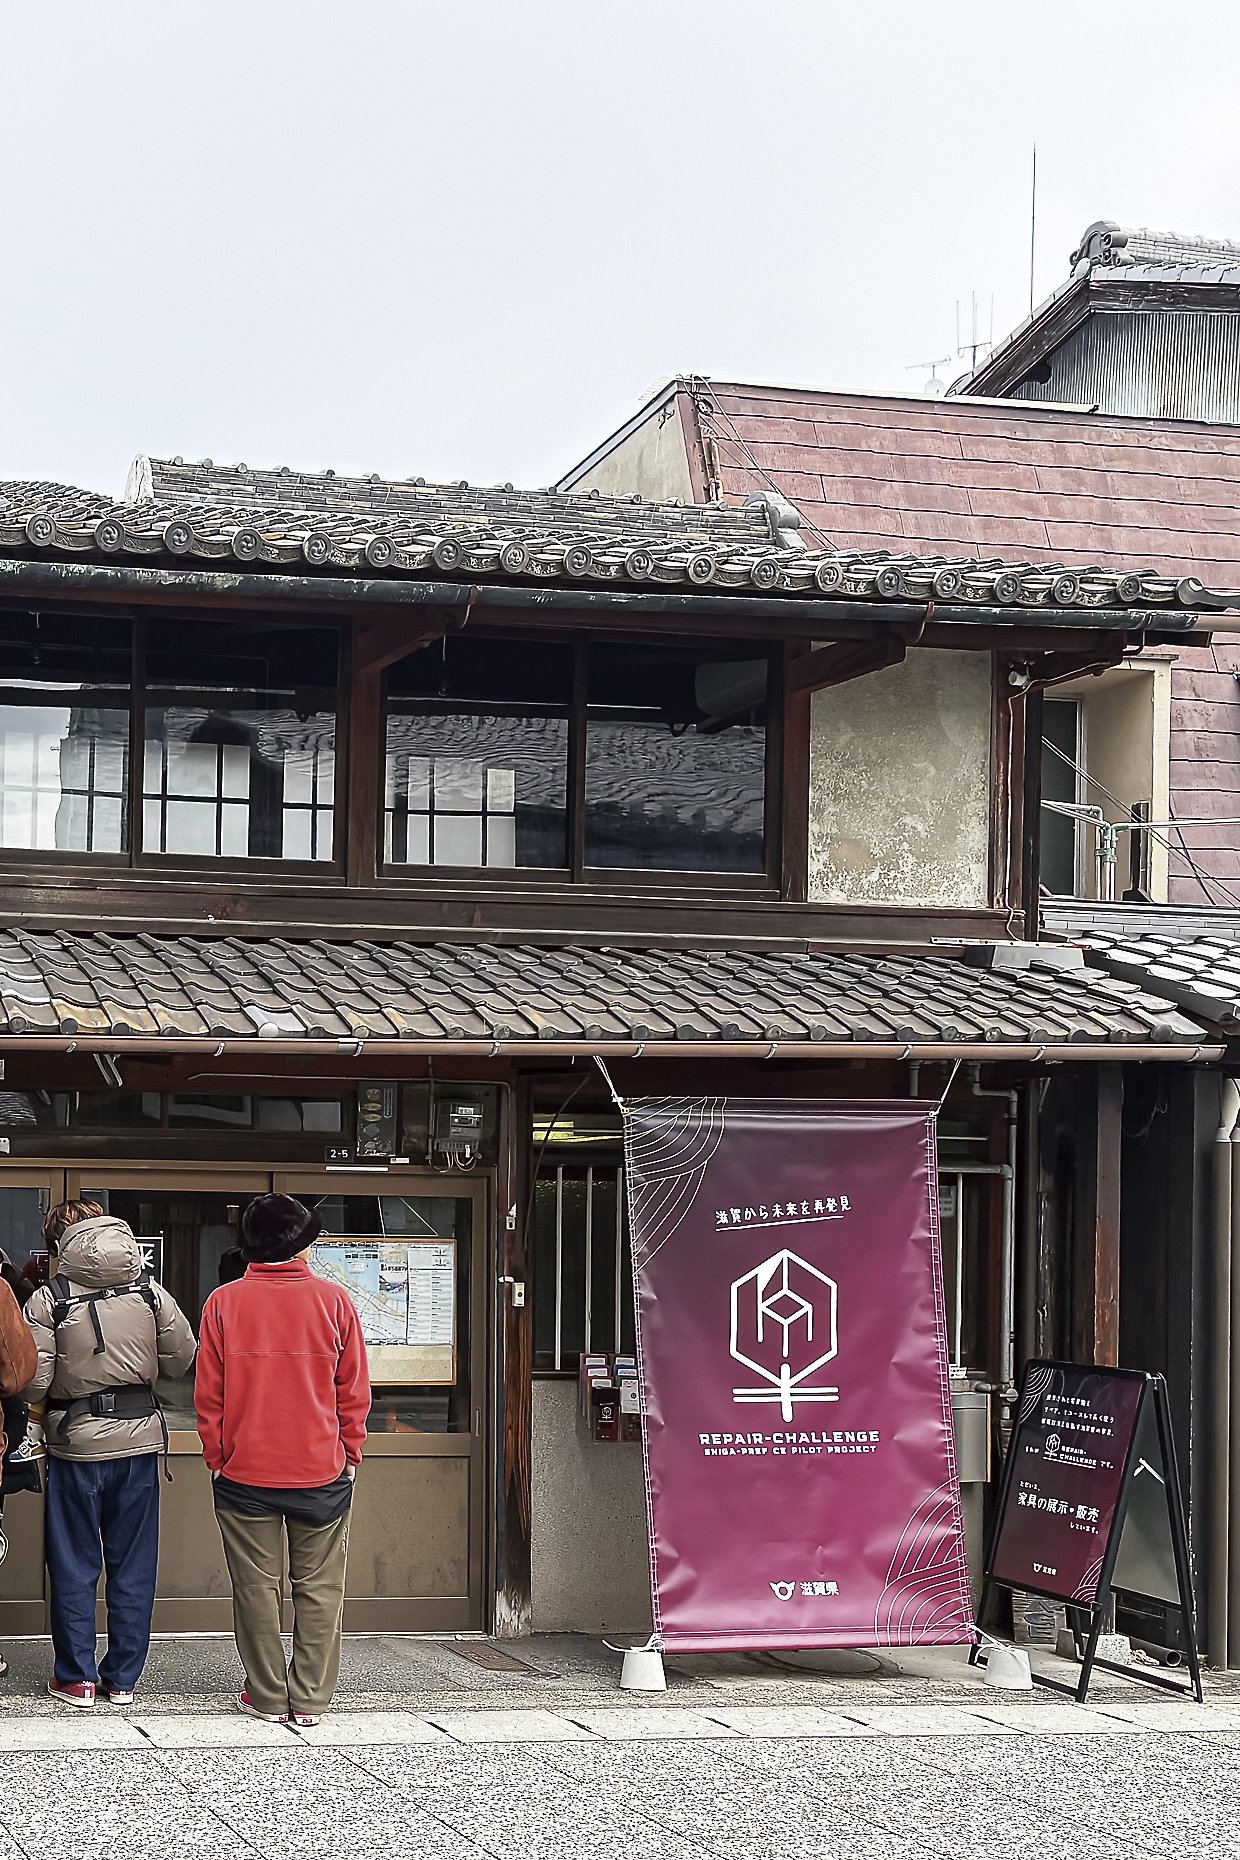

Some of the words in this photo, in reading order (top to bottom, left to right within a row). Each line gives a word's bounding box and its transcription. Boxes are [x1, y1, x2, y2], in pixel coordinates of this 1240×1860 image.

[330, 1149, 349, 1159] 2-5
[715, 1195, 852, 1225] 滋賀から未来を再発見
[698, 1430, 880, 1446] REPAIR-CHALLENGE
[704, 1447, 768, 1456] SHIGA-PREF
[773, 1447, 786, 1455] CE
[791, 1446, 823, 1455] PILOT
[827, 1445, 877, 1454] PROJECT
[1017, 1491, 1100, 1523] 家具の展示・販売
[799, 1581, 840, 1597] 滋賀県
